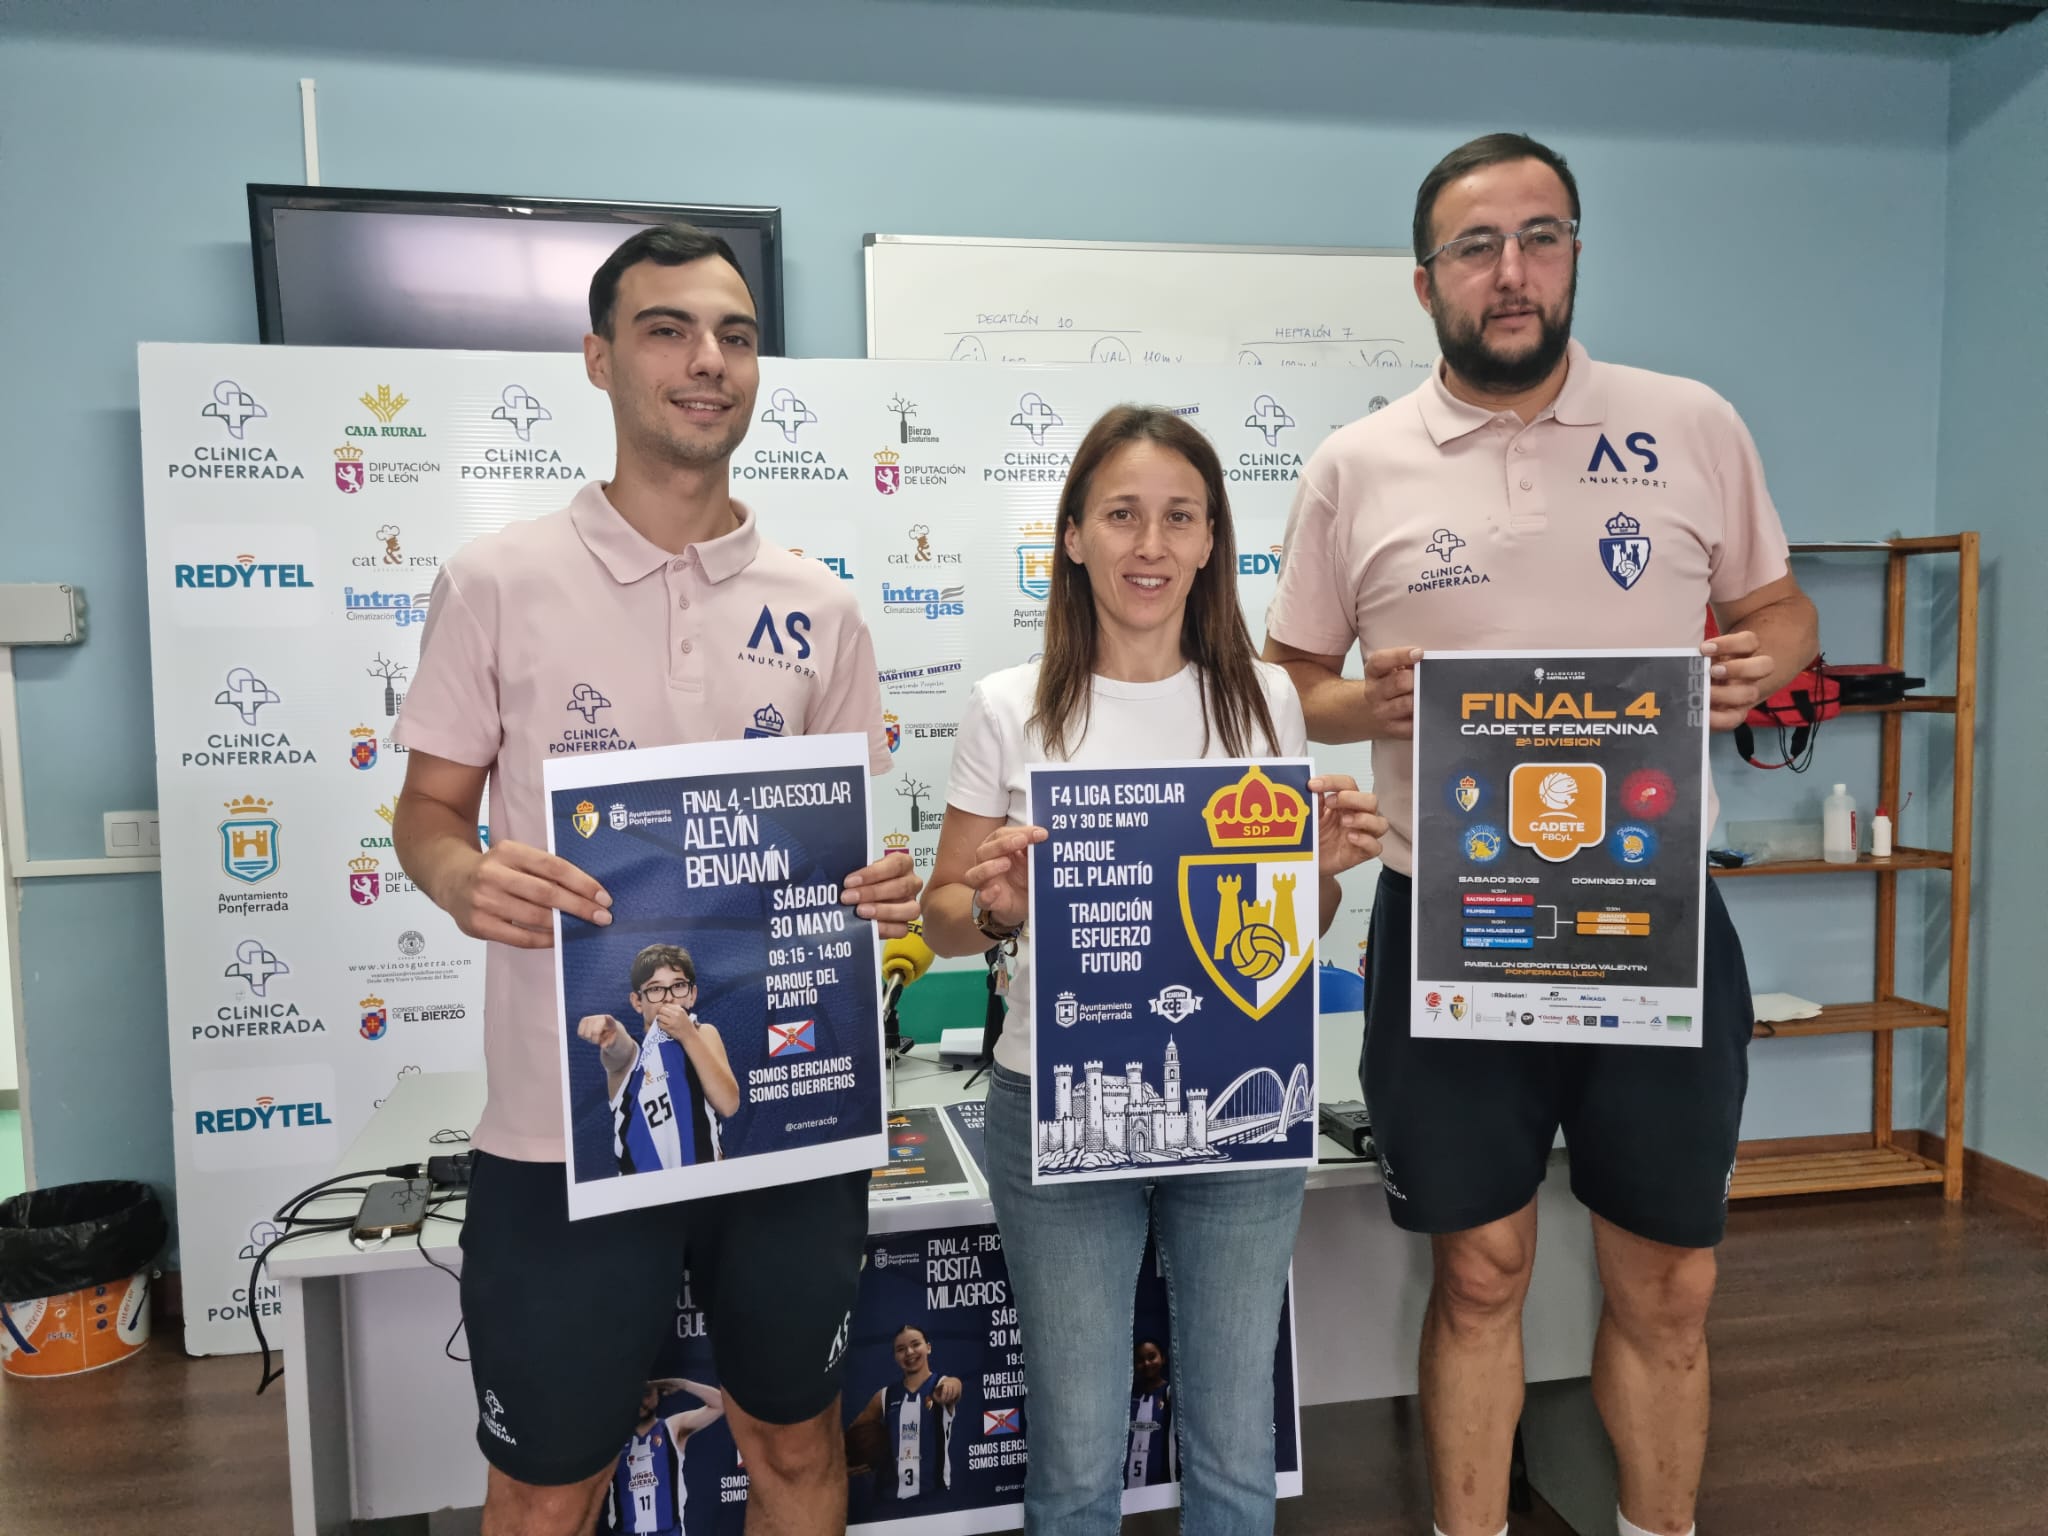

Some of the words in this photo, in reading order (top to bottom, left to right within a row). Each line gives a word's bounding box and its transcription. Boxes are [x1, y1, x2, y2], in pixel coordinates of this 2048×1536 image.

[976, 309, 1038, 325] DECATLÓN
[1058, 318, 1073, 328] 10
[1343, 328, 1353, 339] 7
[345, 426, 377, 437] CAJA
[381, 426, 426, 438] RURAL
[908, 426, 931, 435] Bierzo
[1587, 431, 1659, 473] AS
[168, 463, 304, 480] PONFERRADA
[369, 460, 440, 472] DIPUTACIÓN
[461, 464, 587, 480] PONFERRADA
[732, 466, 848, 481] PONFERRADA
[904, 464, 965, 474] DIPUTACIÓN
[369, 474, 384, 482] DE
[388, 472, 418, 483] LEÓN
[904, 476, 918, 484] DE
[920, 474, 946, 485] LEÓN
[984, 469, 1066, 481] PONFERRA
[1579, 476, 1668, 489] ANUKSPORT
[352, 555, 376, 566] cat
[409, 555, 439, 566] rest
[888, 553, 909, 564] cat
[937, 553, 963, 564] rest
[175, 563, 314, 588] REDYTEL
[1408, 574, 1490, 593] PONFERRADA
[344, 587, 411, 607] intra
[882, 582, 939, 601] intra
[346, 611, 395, 621] Climatización
[395, 609, 426, 627] ga
[884, 605, 925, 614] Climatización
[925, 602, 964, 620] gas
[747, 604, 811, 660] AS
[738, 652, 816, 679] ANUKSPORT
[1461, 692, 1617, 720] FINAL
[1625, 692, 1661, 719] 4
[915, 729, 928, 738] EL
[1461, 723, 1545, 736] CADETE
[1549, 723, 1658, 735] FEMENINA
[549, 740, 637, 753] PONFERRADA
[1534, 737, 1601, 747] DIVISION
[182, 748, 317, 767] PONFERRADA
[682, 788, 726, 814] FINAL
[727, 788, 739, 811] 4
[751, 787, 786, 810] LIGA
[786, 781, 851, 807] ESCOLAR
[1051, 786, 1072, 807] F4
[1074, 785, 1110, 806] LIGA
[1116, 783, 1185, 805] ESCOLAR
[629, 809, 672, 818] Ayuntamiento
[629, 815, 672, 827] Ponferrada
[1052, 814, 1067, 829] 29
[1070, 814, 1078, 829] Y
[1080, 814, 1095, 829] 30
[1099, 813, 1113, 828] DE
[1115, 812, 1149, 827] MAYO
[684, 811, 759, 850] ALEVÍN
[1243, 825, 1270, 836] SDP
[1529, 822, 1585, 832] CADETE
[360, 837, 393, 848] CAJA
[1542, 833, 1572, 842] FBCyL
[1053, 840, 1115, 862] PARQUE
[685, 845, 790, 888] BENJAMÍN
[914, 858, 928, 867] DE
[1053, 866, 1083, 888] DEL
[1087, 861, 1152, 887] PLANTÍO
[1458, 876, 1505, 884] SABADO
[1572, 877, 1624, 885] DOMINGO
[1626, 878, 1657, 886] 31/05
[385, 884, 400, 892] DE
[219, 890, 288, 904] Ayuntamiento
[773, 884, 838, 911] SÁBADO
[218, 900, 289, 916] Ponferrada
[1069, 897, 1152, 923] TRADICIÓN
[770, 915, 793, 939] 30
[796, 910, 845, 936] MAYO
[1071, 925, 1151, 949] ESFUERZO
[769, 949, 805, 967] 09:15
[817, 942, 852, 961] 14:00
[1081, 951, 1142, 973] FUTURO
[348, 959, 472, 971] www.vinosguerra.com
[1464, 961, 1515, 969] PABELLON
[1517, 961, 1569, 970] DEPORTES
[1598, 963, 1648, 971] VALENTIN
[1504, 968, 1571, 977] PONFERRADA
[766, 971, 813, 992] PARQUE
[816, 968, 838, 985] DEL
[767, 987, 818, 1010] PLANTÍO
[1079, 1001, 1132, 1012] Ayuntamiento
[426, 1003, 465, 1011] COMARCAL
[403, 1012, 419, 1022] EL
[422, 1009, 466, 1021] BIERZO
[1079, 1010, 1132, 1023] Ponferrada
[192, 1019, 325, 1040] PONFERRADA
[748, 1066, 788, 1085] SOMOS
[790, 1056, 852, 1078] BERCIANOS
[749, 1084, 789, 1103] SOMOS
[791, 1073, 855, 1097] GUERREROS
[195, 1102, 332, 1134] REDYTEL
[644, 1092, 672, 1128] 25
[785, 1115, 838, 1132] @canteracdp
[927, 1238, 960, 1257] FINAL
[961, 1237, 969, 1253] 4
[926, 1256, 982, 1283] ROSITA
[927, 1280, 1006, 1311] MILAGROS
[992, 1306, 1018, 1326] SÁB
[989, 1330, 1006, 1347] 30
[983, 1369, 1024, 1386] PABELLÓ
[968, 1443, 998, 1457] SOMOS
[968, 1456, 999, 1470] SOMOS
[1134, 1461, 1142, 1477] 5
[905, 1468, 914, 1486] 3
[640, 1495, 651, 1511] 11
[720, 1489, 748, 1503] SOMO
